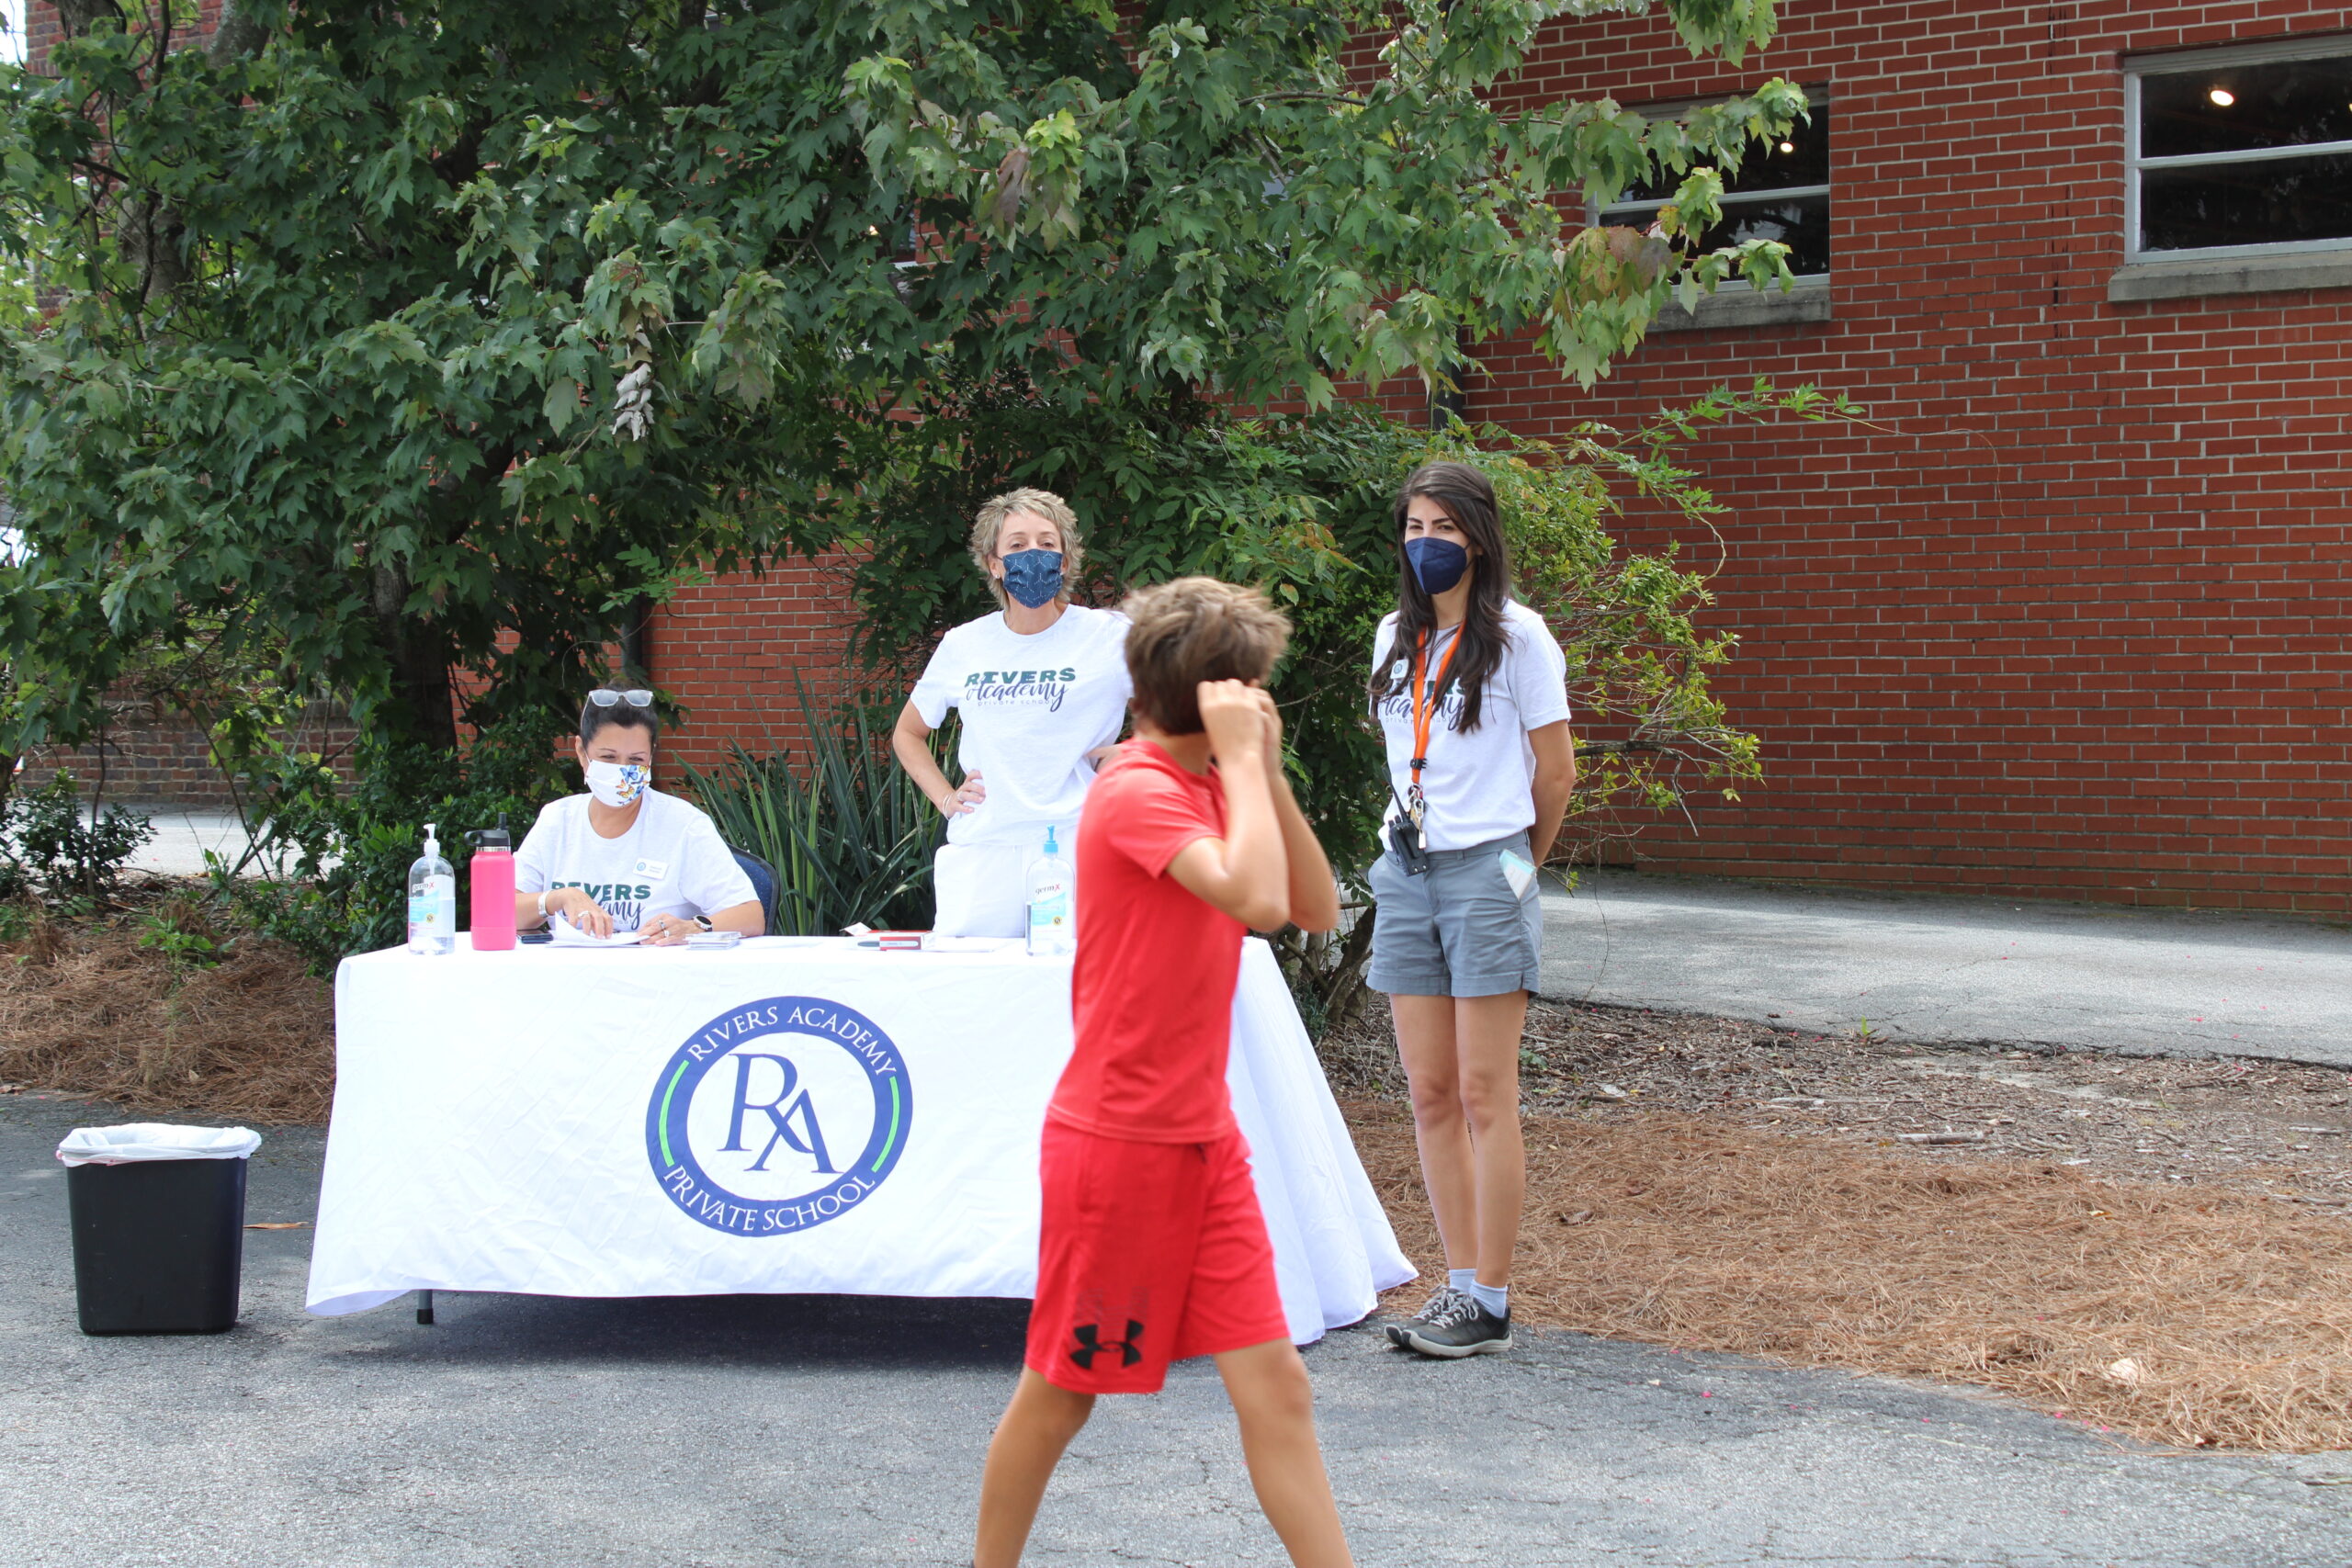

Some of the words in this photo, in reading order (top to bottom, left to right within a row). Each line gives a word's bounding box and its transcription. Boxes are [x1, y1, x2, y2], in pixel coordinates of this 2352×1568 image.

[965, 668, 1076, 687] RIVERS
[967, 678, 1069, 712] Academy
[687, 1006, 779, 1062] RIVERS
[787, 1006, 897, 1076] ACADEMY
[717, 1054, 845, 1175] RA
[663, 1165, 758, 1231] PRIVATE
[763, 1175, 876, 1231] SCHOOL
